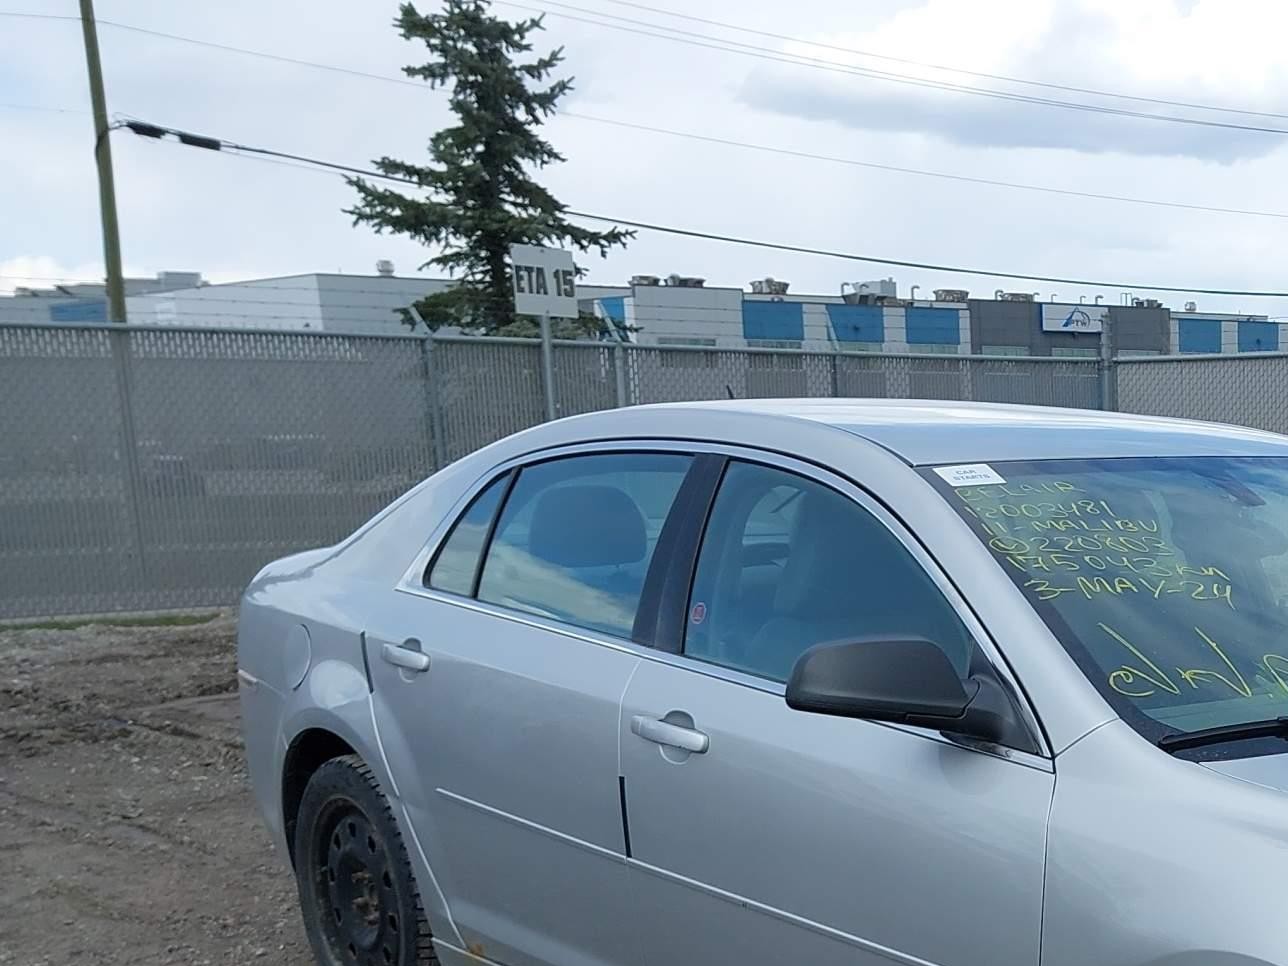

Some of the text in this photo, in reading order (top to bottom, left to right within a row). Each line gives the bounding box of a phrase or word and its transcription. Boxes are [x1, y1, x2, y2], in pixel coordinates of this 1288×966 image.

[515, 265, 575, 298] ETA 15
[964, 500, 1116, 518] 12003481
